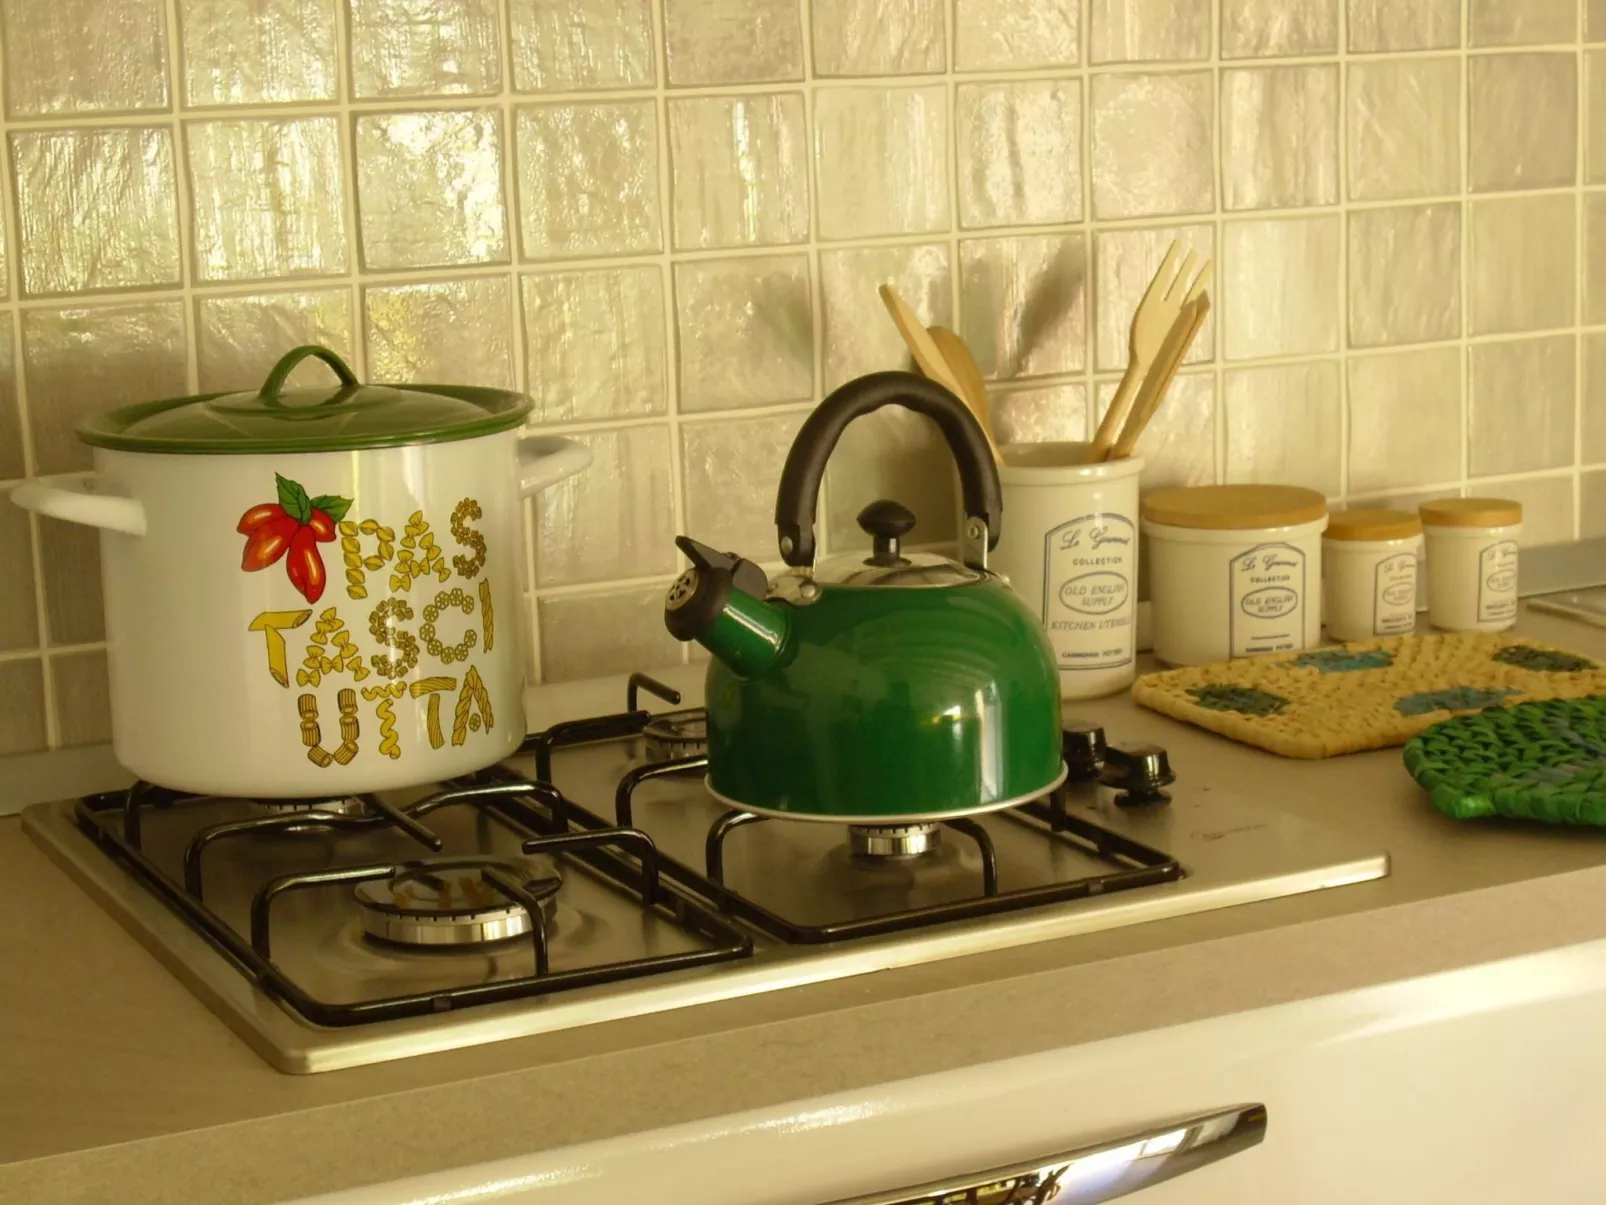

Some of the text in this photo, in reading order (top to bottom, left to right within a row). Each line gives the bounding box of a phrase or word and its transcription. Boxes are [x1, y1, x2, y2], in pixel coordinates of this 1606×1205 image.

[1072, 556, 1123, 566] COLLECTION
[1064, 586, 1087, 596] OLD
[1050, 621, 1096, 631] KITCHEN
